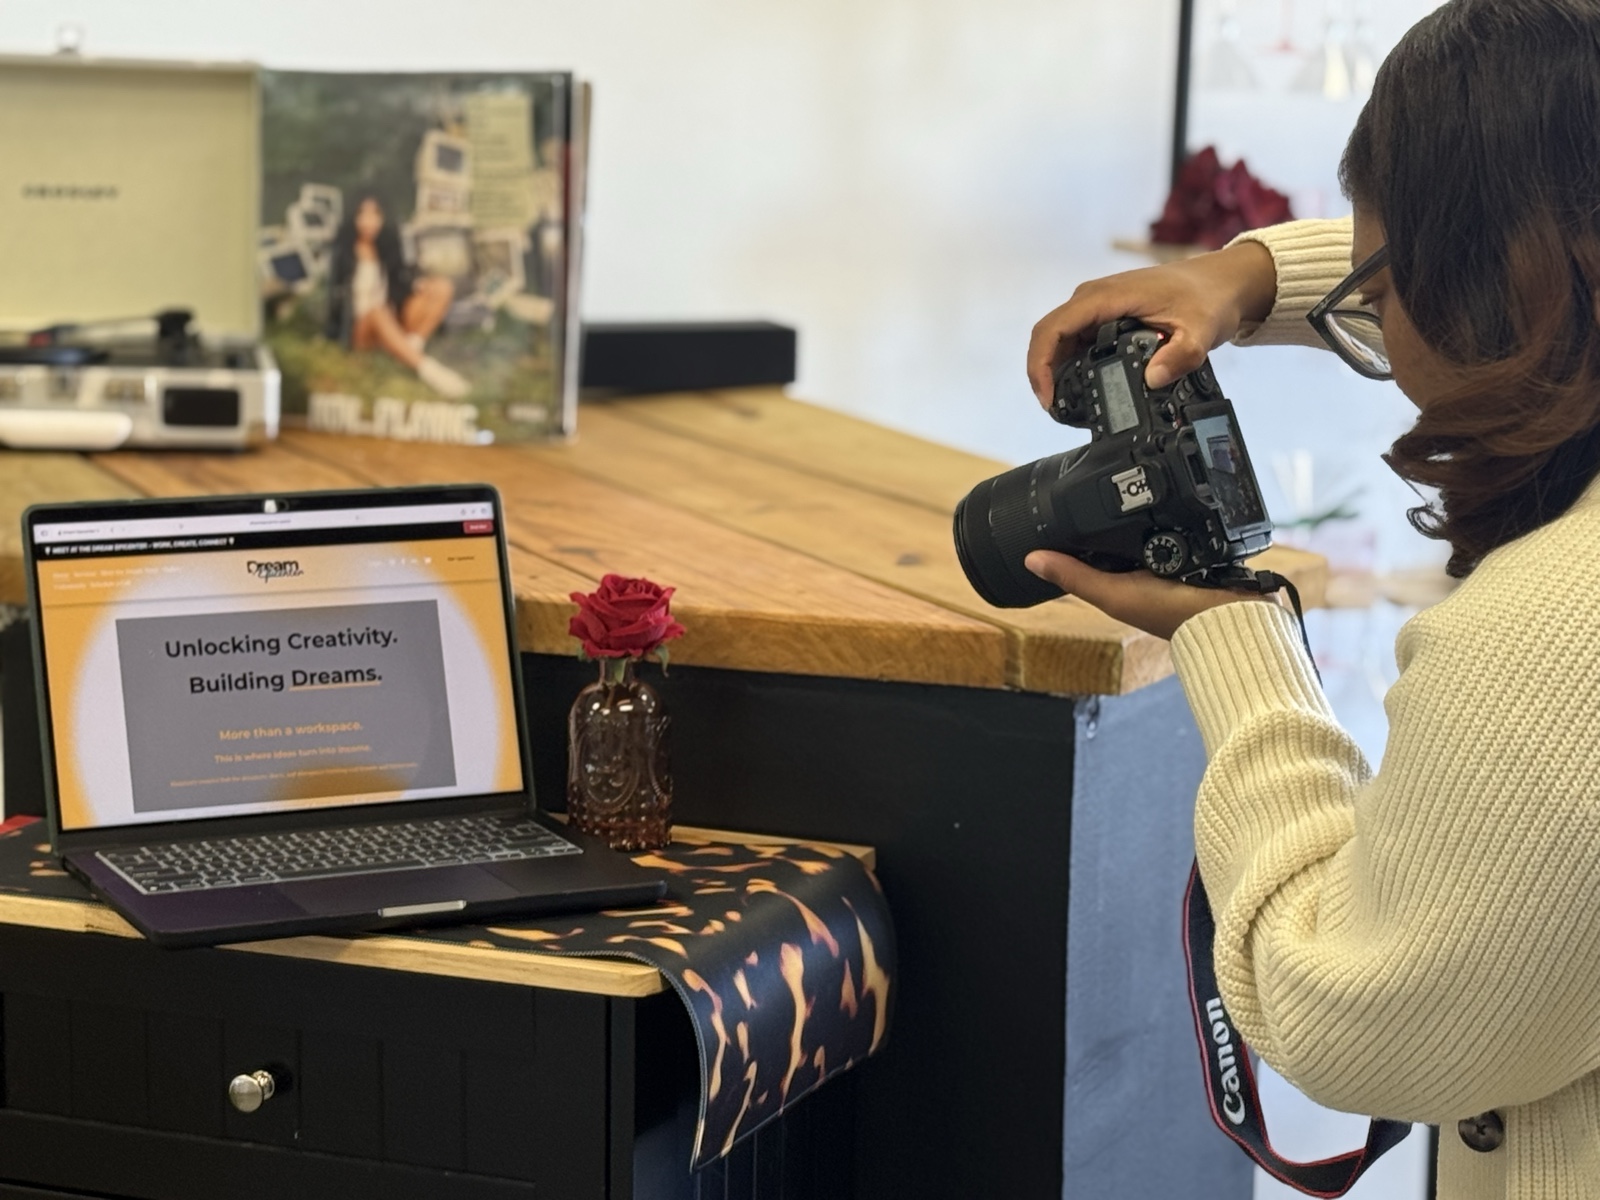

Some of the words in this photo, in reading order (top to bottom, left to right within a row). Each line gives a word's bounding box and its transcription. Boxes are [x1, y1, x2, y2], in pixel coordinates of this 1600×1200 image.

[247, 560, 299, 574] Dream
[165, 635, 281, 659] Unlocking
[288, 627, 399, 650] Creativity.
[189, 671, 285, 694] Building
[291, 666, 383, 687] Dreams.
[219, 729, 251, 741] More
[253, 727, 282, 739] than
[284, 727, 293, 736] a
[295, 722, 364, 735] workspace.
[214, 754, 233, 764] This
[234, 753, 242, 762] is
[243, 751, 273, 761] where
[298, 748, 317, 757] turn
[1205, 996, 1246, 1126] Canon
